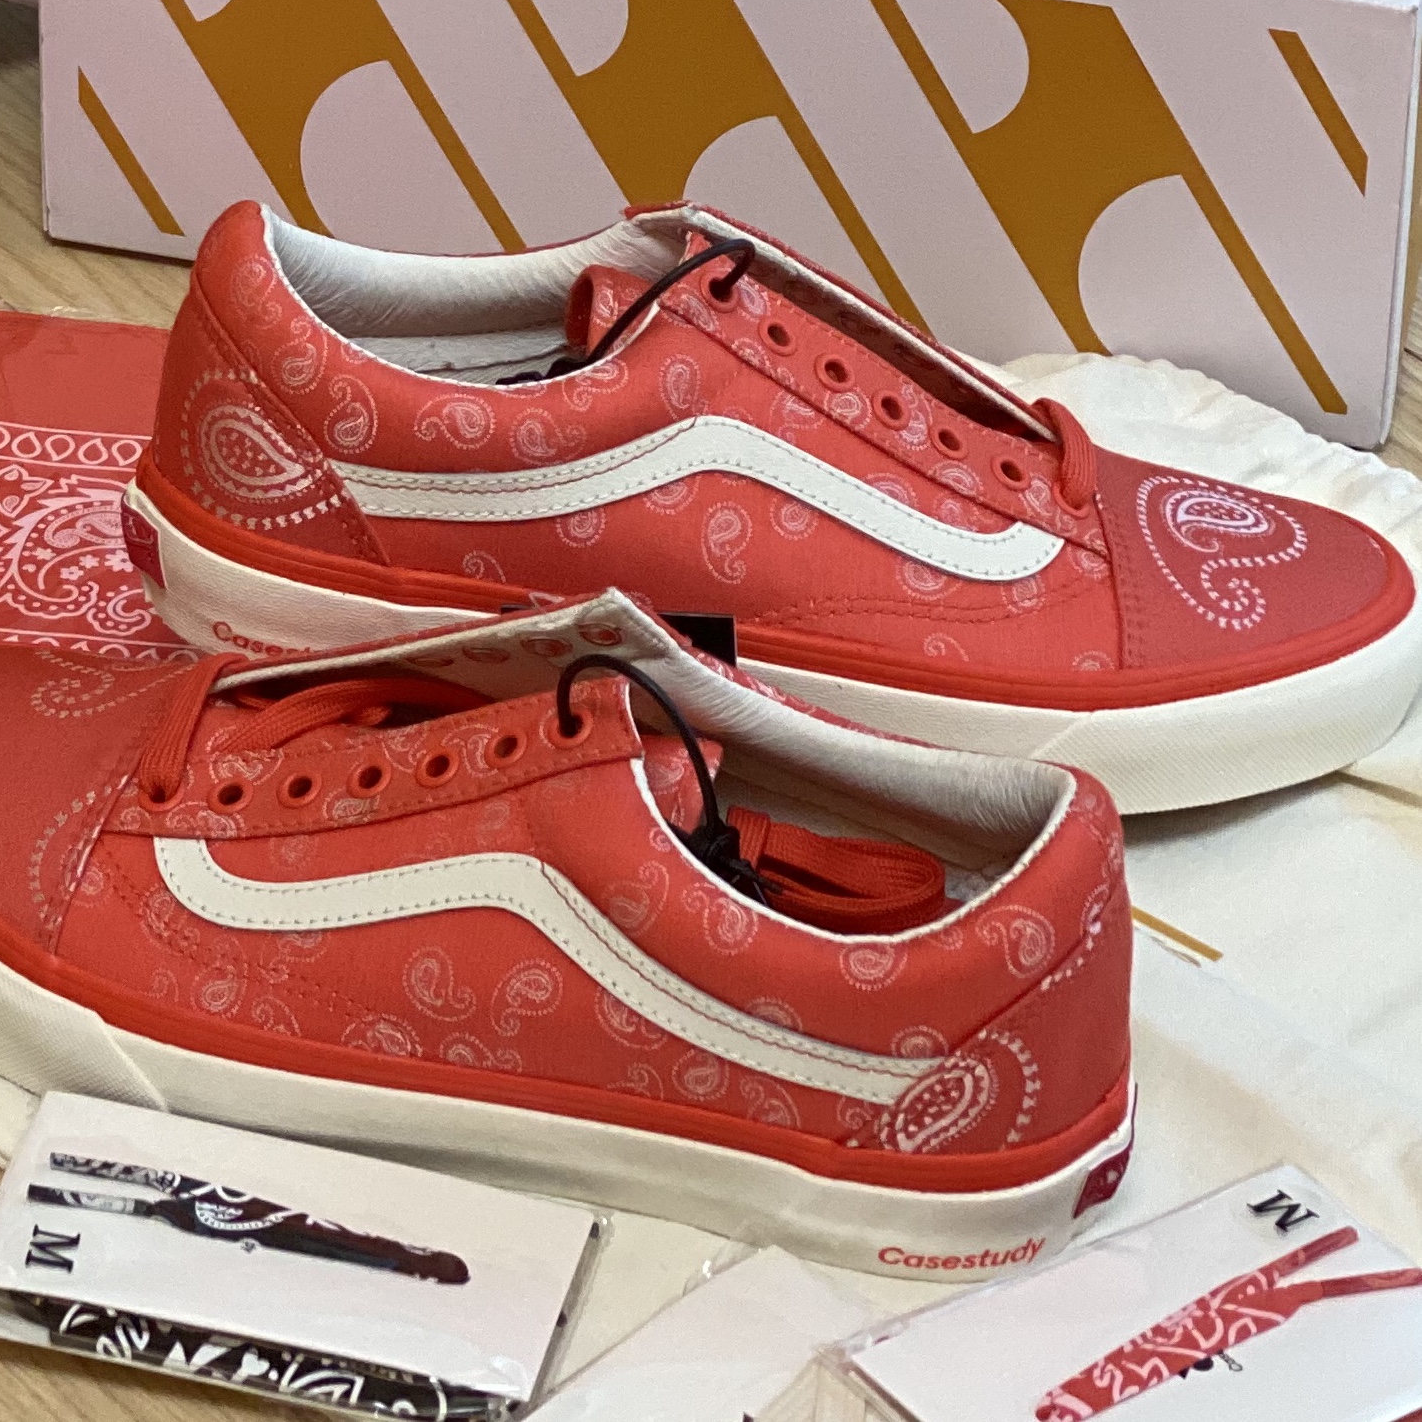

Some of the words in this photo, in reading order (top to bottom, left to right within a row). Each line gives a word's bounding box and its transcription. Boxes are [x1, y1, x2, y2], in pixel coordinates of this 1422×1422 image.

[1246, 1188, 1320, 1233] M
[25, 1223, 81, 1274] M
[878, 1237, 1046, 1270] Casestudy
